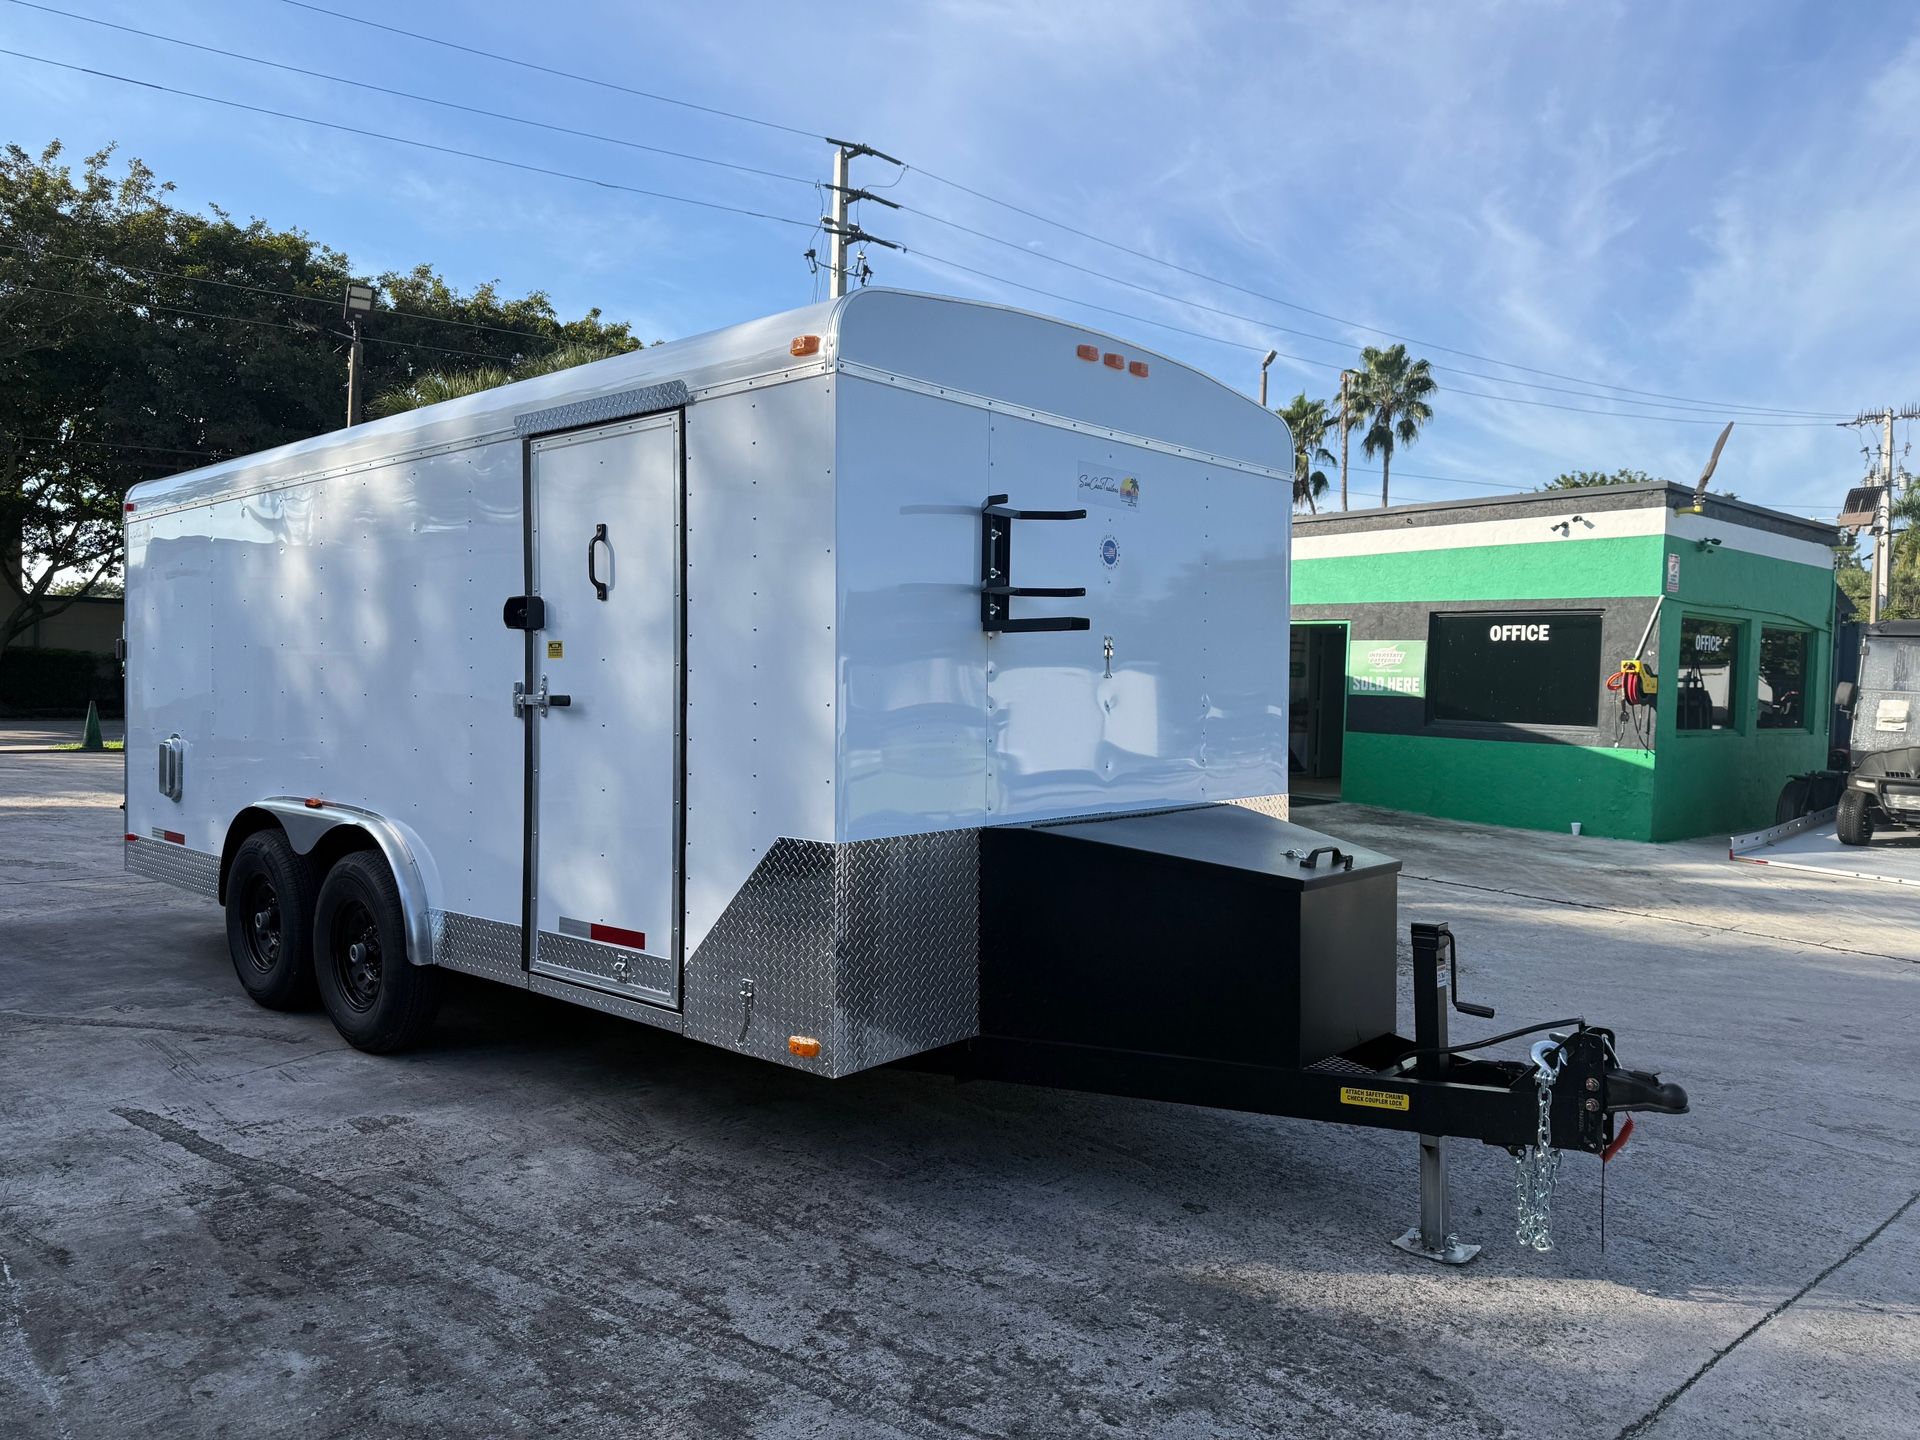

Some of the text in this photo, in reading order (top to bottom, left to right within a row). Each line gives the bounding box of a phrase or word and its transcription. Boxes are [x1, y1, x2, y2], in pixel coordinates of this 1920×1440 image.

[1489, 624, 1550, 642] OFFICE
[1695, 634, 1720, 651] OFFICE
[1353, 676, 1420, 692] SOLD HERE
